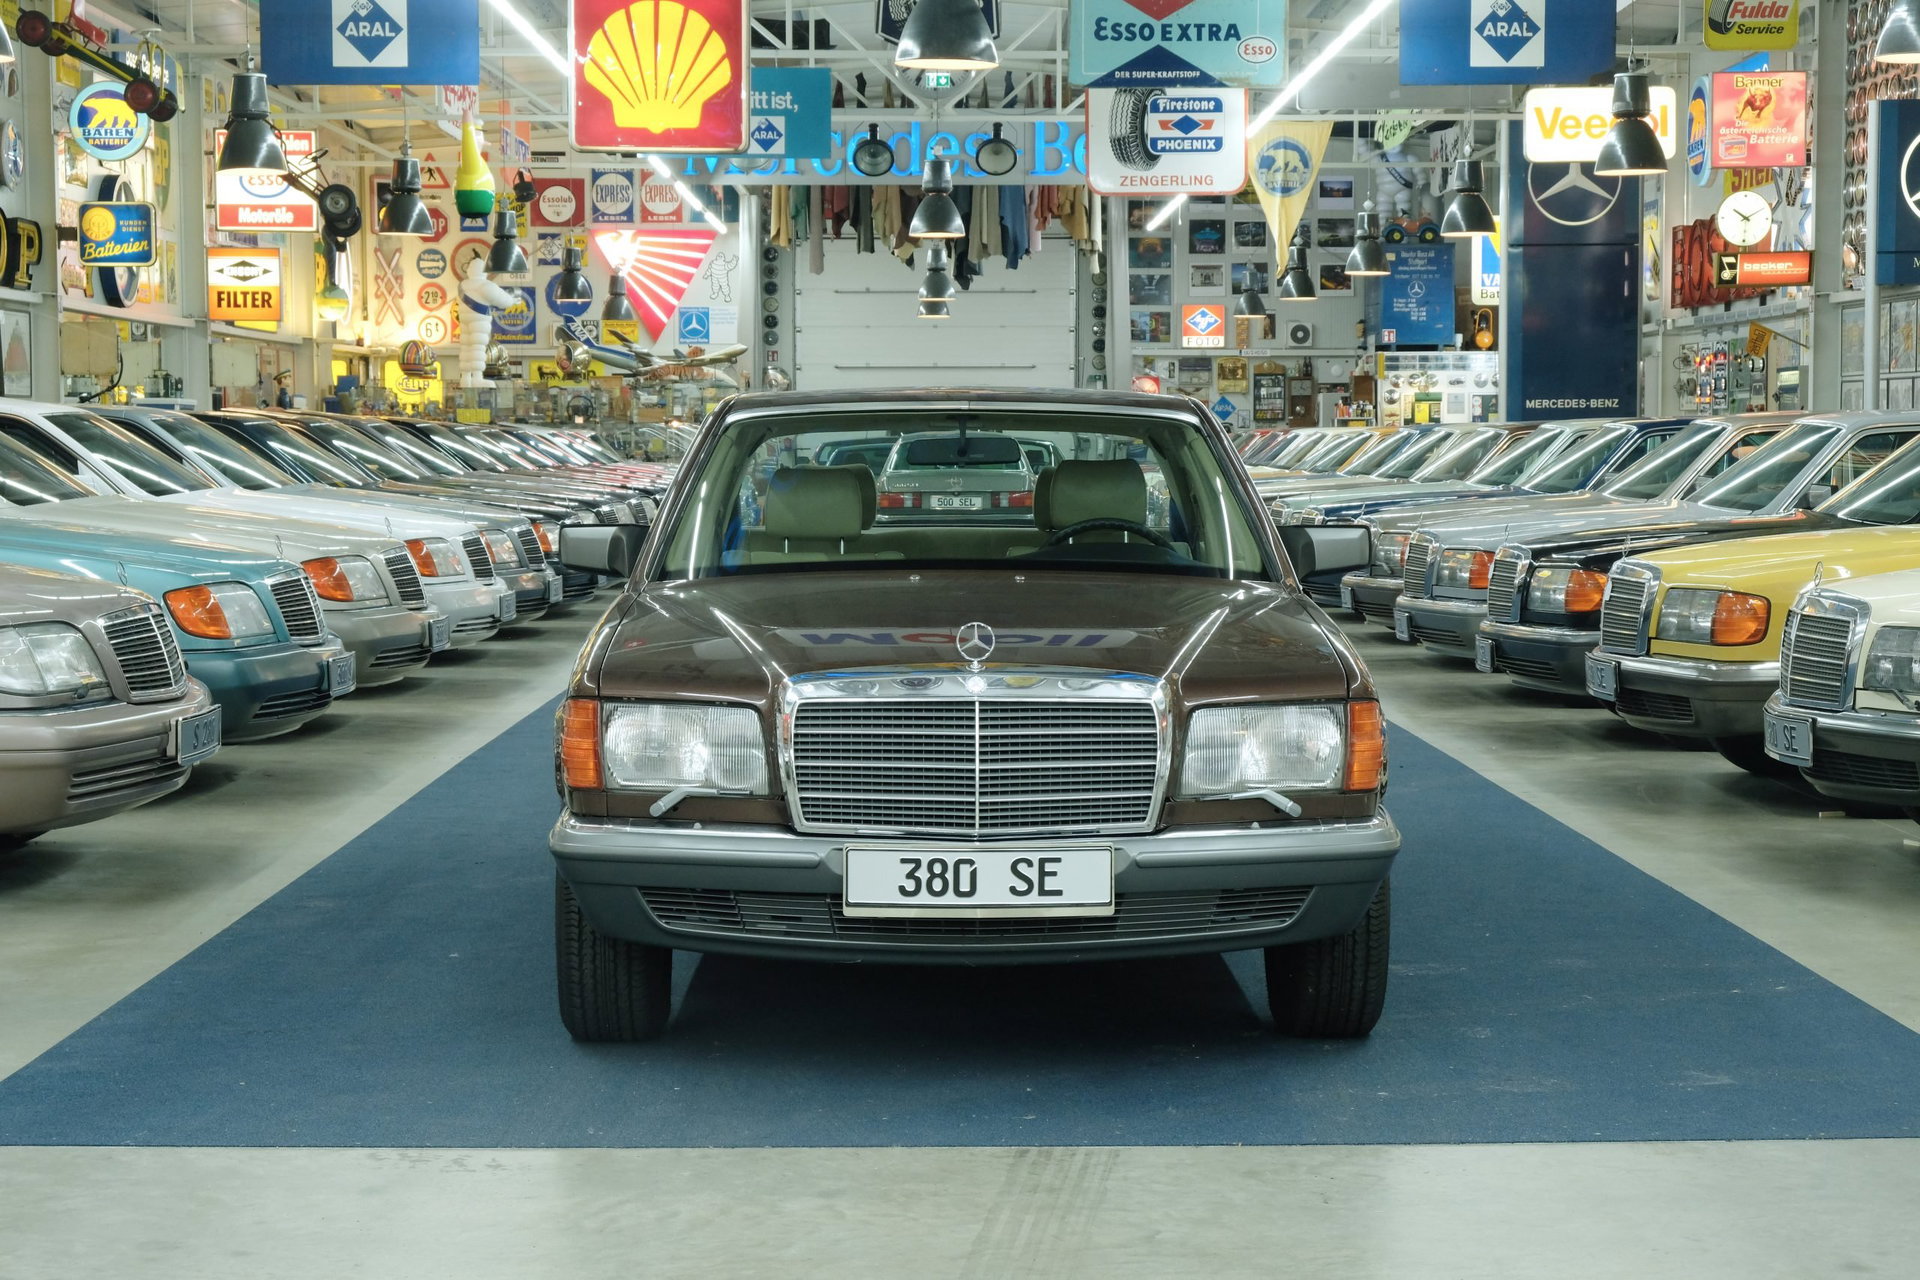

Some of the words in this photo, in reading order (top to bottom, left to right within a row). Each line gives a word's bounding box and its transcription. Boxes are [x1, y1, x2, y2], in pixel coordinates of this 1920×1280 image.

[1729, 1, 1789, 18] Fulda
[344, 21, 396, 37] ARAL
[1160, 23, 1242, 42] EXTRA
[1482, 21, 1533, 37] ARAL
[1735, 23, 1785, 35] Service
[1114, 70, 1132, 79] DER
[1132, 70, 1201, 79] SUPER-KRAFTSTOFF
[1734, 76, 1785, 88] Banner
[771, 91, 799, 113] ist,
[1156, 99, 1216, 112] Firestone
[1534, 105, 1668, 139] Veel
[1735, 119, 1750, 128] Die
[82, 127, 135, 137] BÄREN
[752, 130, 780, 140] ARAL
[88, 138, 130, 146] BATTERIE
[1156, 139, 1216, 150] PHOENIX
[1749, 134, 1799, 145] Batterie
[1119, 175, 1214, 188] ZENGERLING
[542, 195, 574, 204] Essolub
[595, 184, 631, 203] EXPRESS
[644, 184, 679, 203] EXPRESS
[82, 237, 150, 260] Batterien
[216, 291, 273, 308] FILTER
[424, 291, 431, 305] 2
[431, 291, 439, 300] 10
[425, 322, 433, 338] 6
[435, 322, 439, 333] t
[568, 321, 588, 342] ANA
[1186, 337, 1221, 346] FOTO
[1525, 399, 1620, 409] MERCEDES-BENZ
[937, 497, 954, 506] 500
[958, 497, 977, 507] SEL
[192, 721, 200, 750] S
[1783, 723, 1799, 753] SE
[897, 856, 978, 899] 380
[1008, 856, 1064, 899] SE
